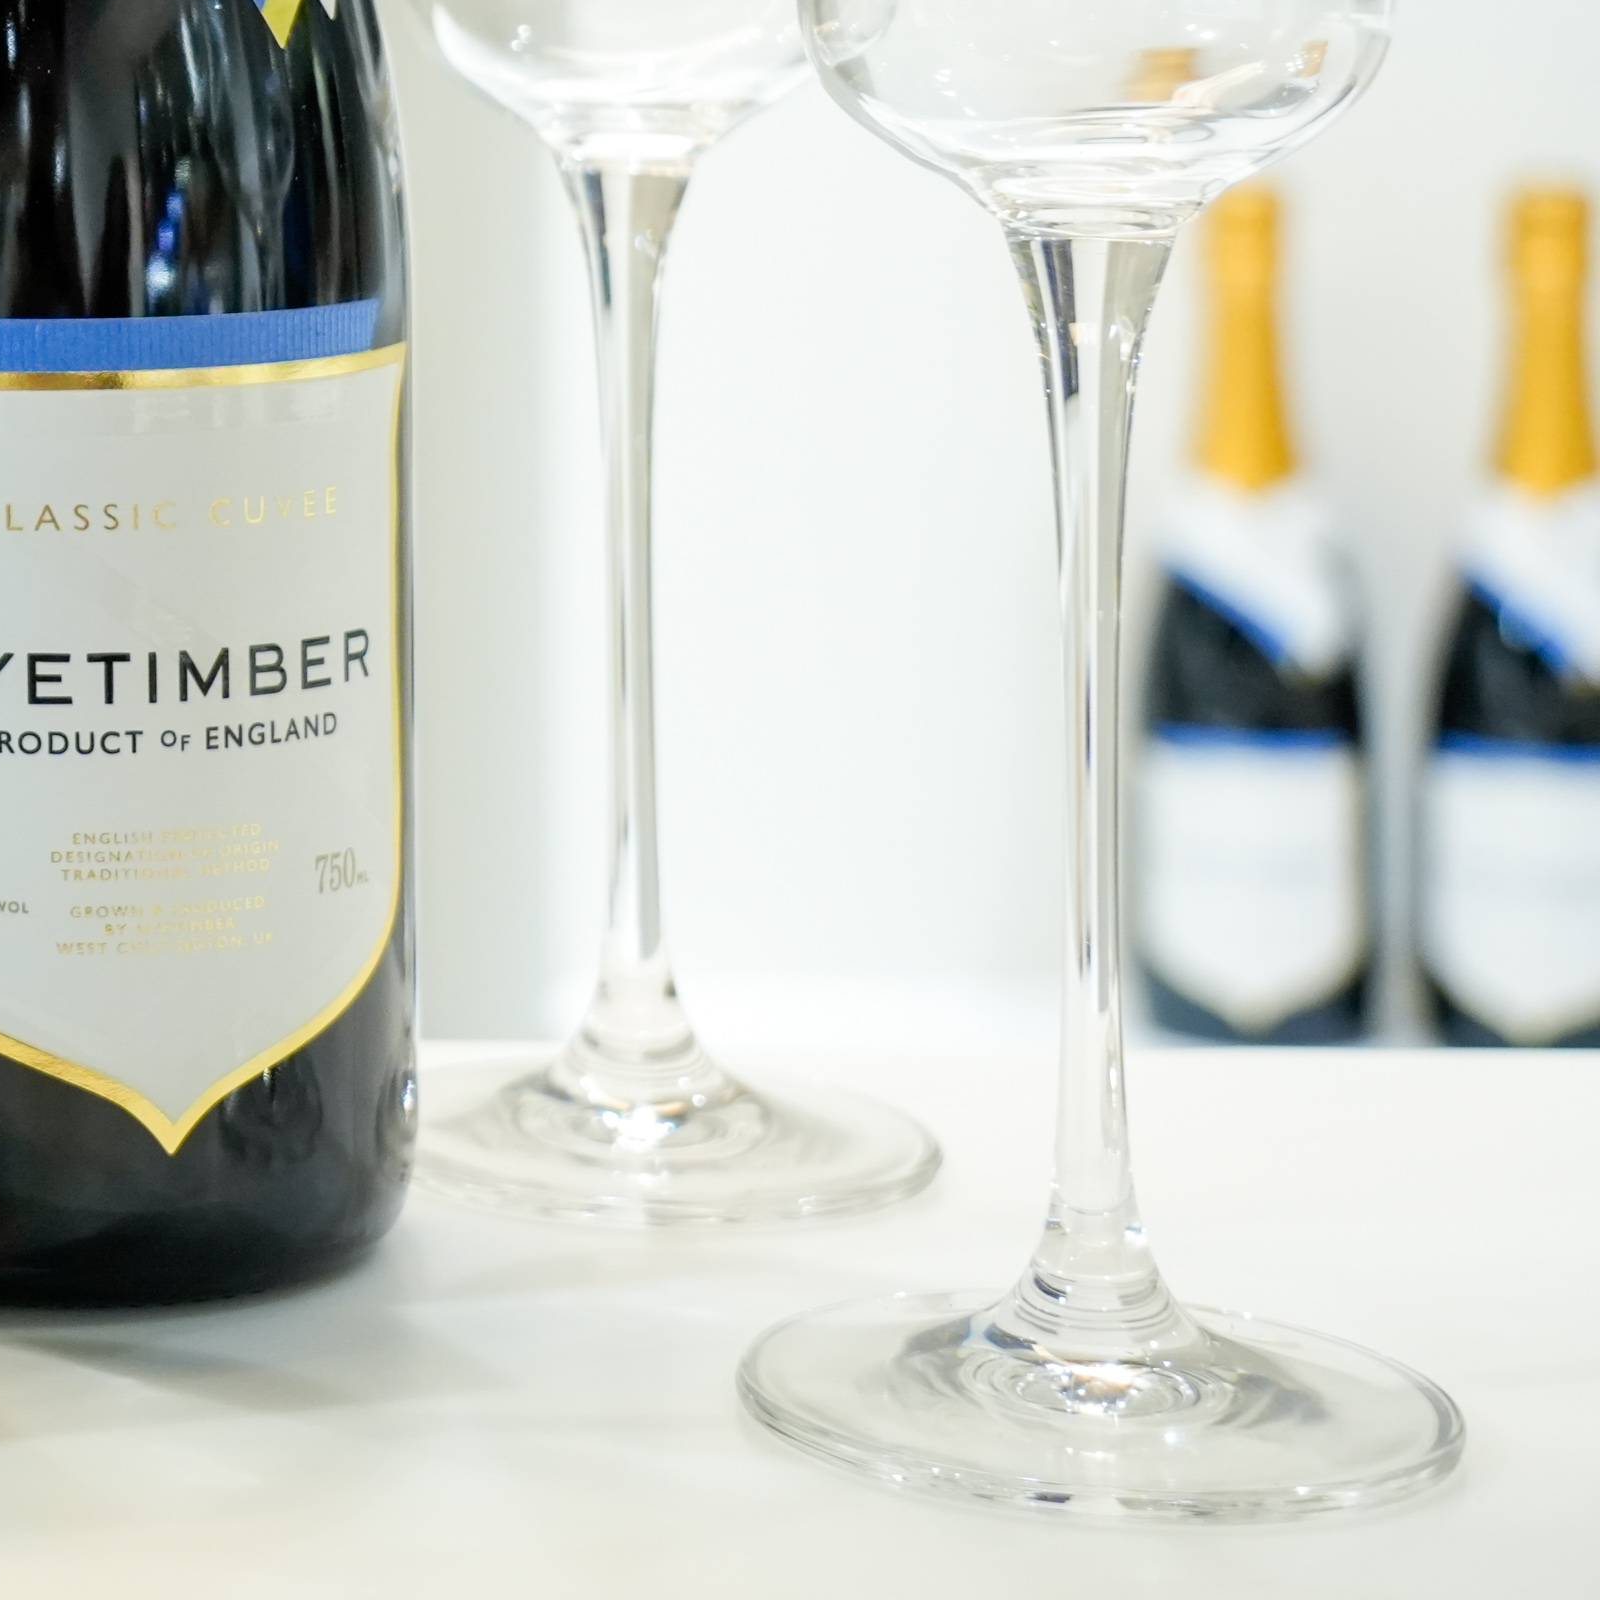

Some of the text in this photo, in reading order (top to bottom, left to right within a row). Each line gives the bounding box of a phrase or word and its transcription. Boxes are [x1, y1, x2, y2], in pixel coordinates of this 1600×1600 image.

[208, 486, 337, 526] CUVEE
[160, 729, 191, 752] OF
[205, 712, 338, 751] ENGLAND
[72, 831, 153, 845] ENGLISH
[51, 849, 183, 864] DESIGNATION
[220, 839, 281, 857] ORIGIN
[199, 858, 270, 876] METHOD
[69, 904, 143, 919] GROWN
[104, 923, 127, 935] BY
[56, 942, 107, 955] WEST
